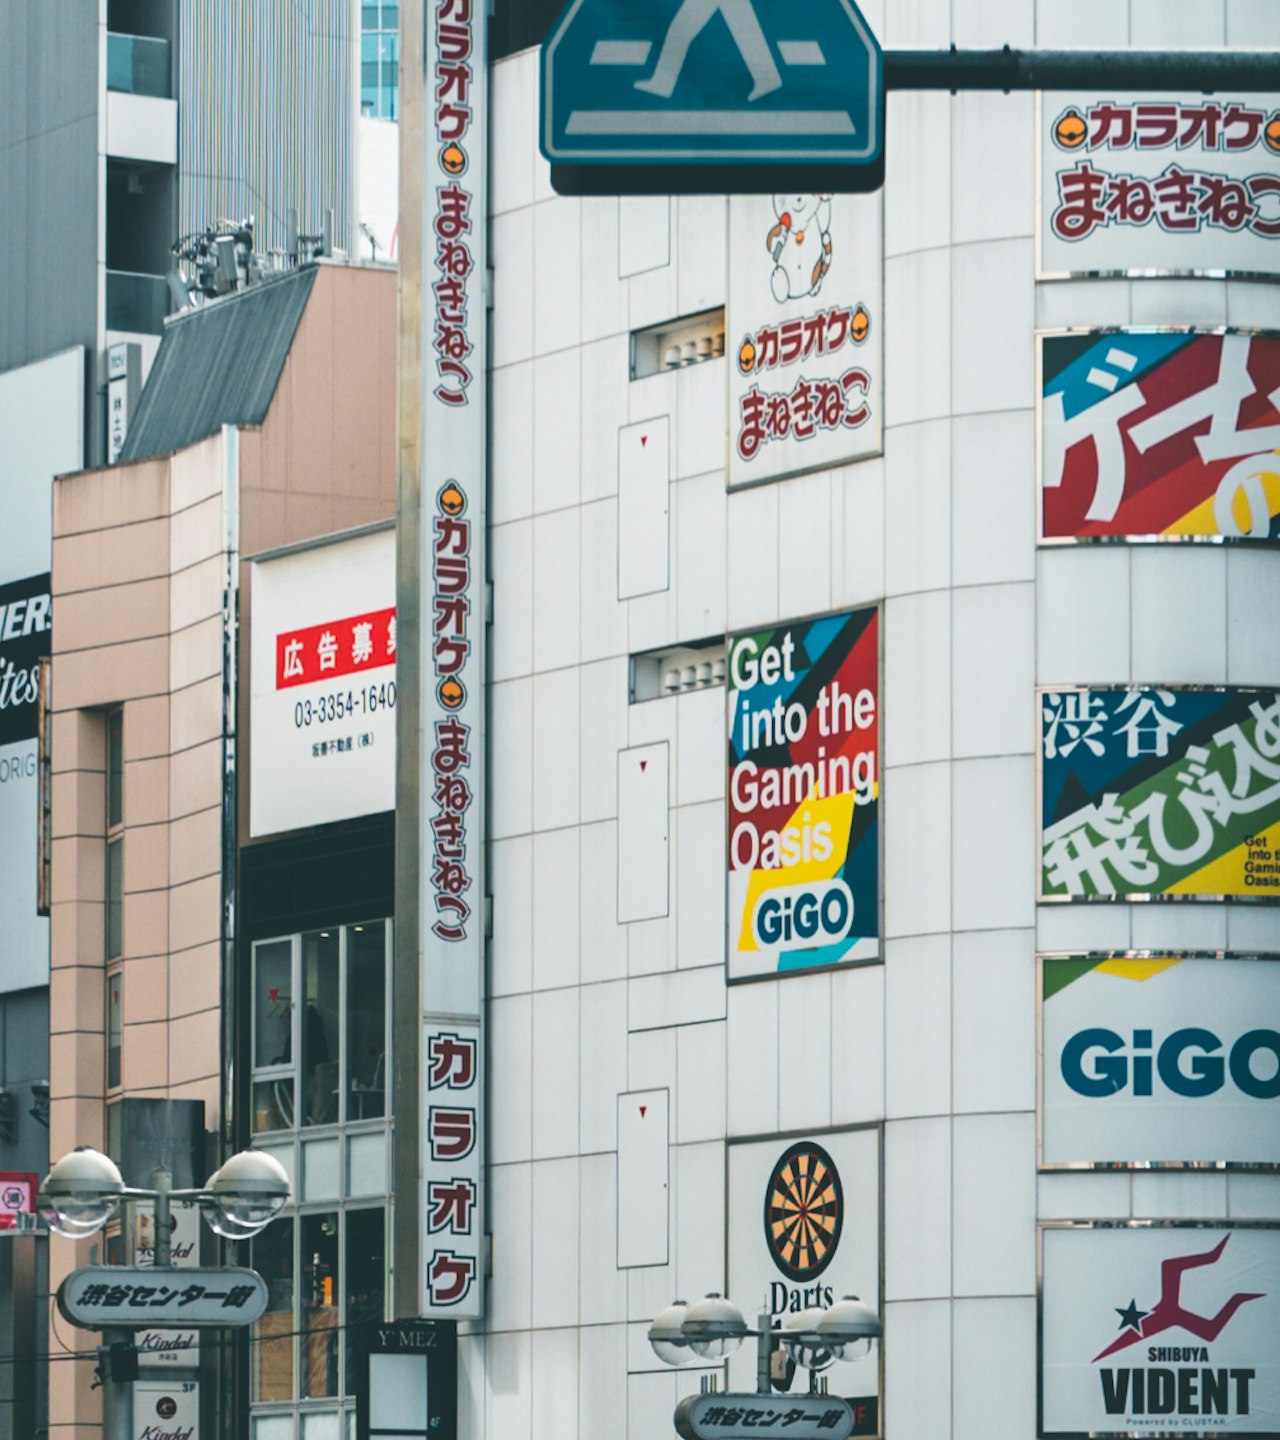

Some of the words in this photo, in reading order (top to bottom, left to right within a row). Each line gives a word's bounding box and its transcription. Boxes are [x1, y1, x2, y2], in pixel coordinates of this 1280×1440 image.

[1084, 100, 1266, 153] カラオケ
[432, 181, 476, 407] まねきねこ
[755, 308, 852, 372] カラオケ
[736, 369, 872, 461] まねきねこ
[431, 515, 474, 681] カラオケ
[730, 629, 796, 693] Get
[295, 684, 397, 730] 03-3354-1640
[740, 696, 807, 751] into
[817, 682, 876, 742] the
[1042, 692, 1184, 759] 渋谷
[730, 747, 878, 816] Gaming
[429, 714, 474, 943] まねきねこ
[730, 813, 833, 872] Oasis
[1244, 834, 1267, 847] Get
[1248, 848, 1272, 861] into
[1244, 874, 1280, 886] Oasis
[755, 886, 849, 945] GiGO
[428, 1033, 477, 1307] カラオケ
[76, 1284, 257, 1309] 渋谷センター街
[771, 1281, 834, 1316] Darts
[141, 1331, 196, 1351] Kindal
[400, 1329, 439, 1348] MEZ
[1148, 1347, 1209, 1362] SHIBUYA
[182, 1382, 197, 1394] 3F
[1099, 1368, 1256, 1416] VIDENT
[429, 1417, 441, 1428] 4F
[699, 1405, 847, 1431] 渋谷センター街
[1126, 1418, 1166, 1427] Powered
[1168, 1418, 1179, 1428] by
